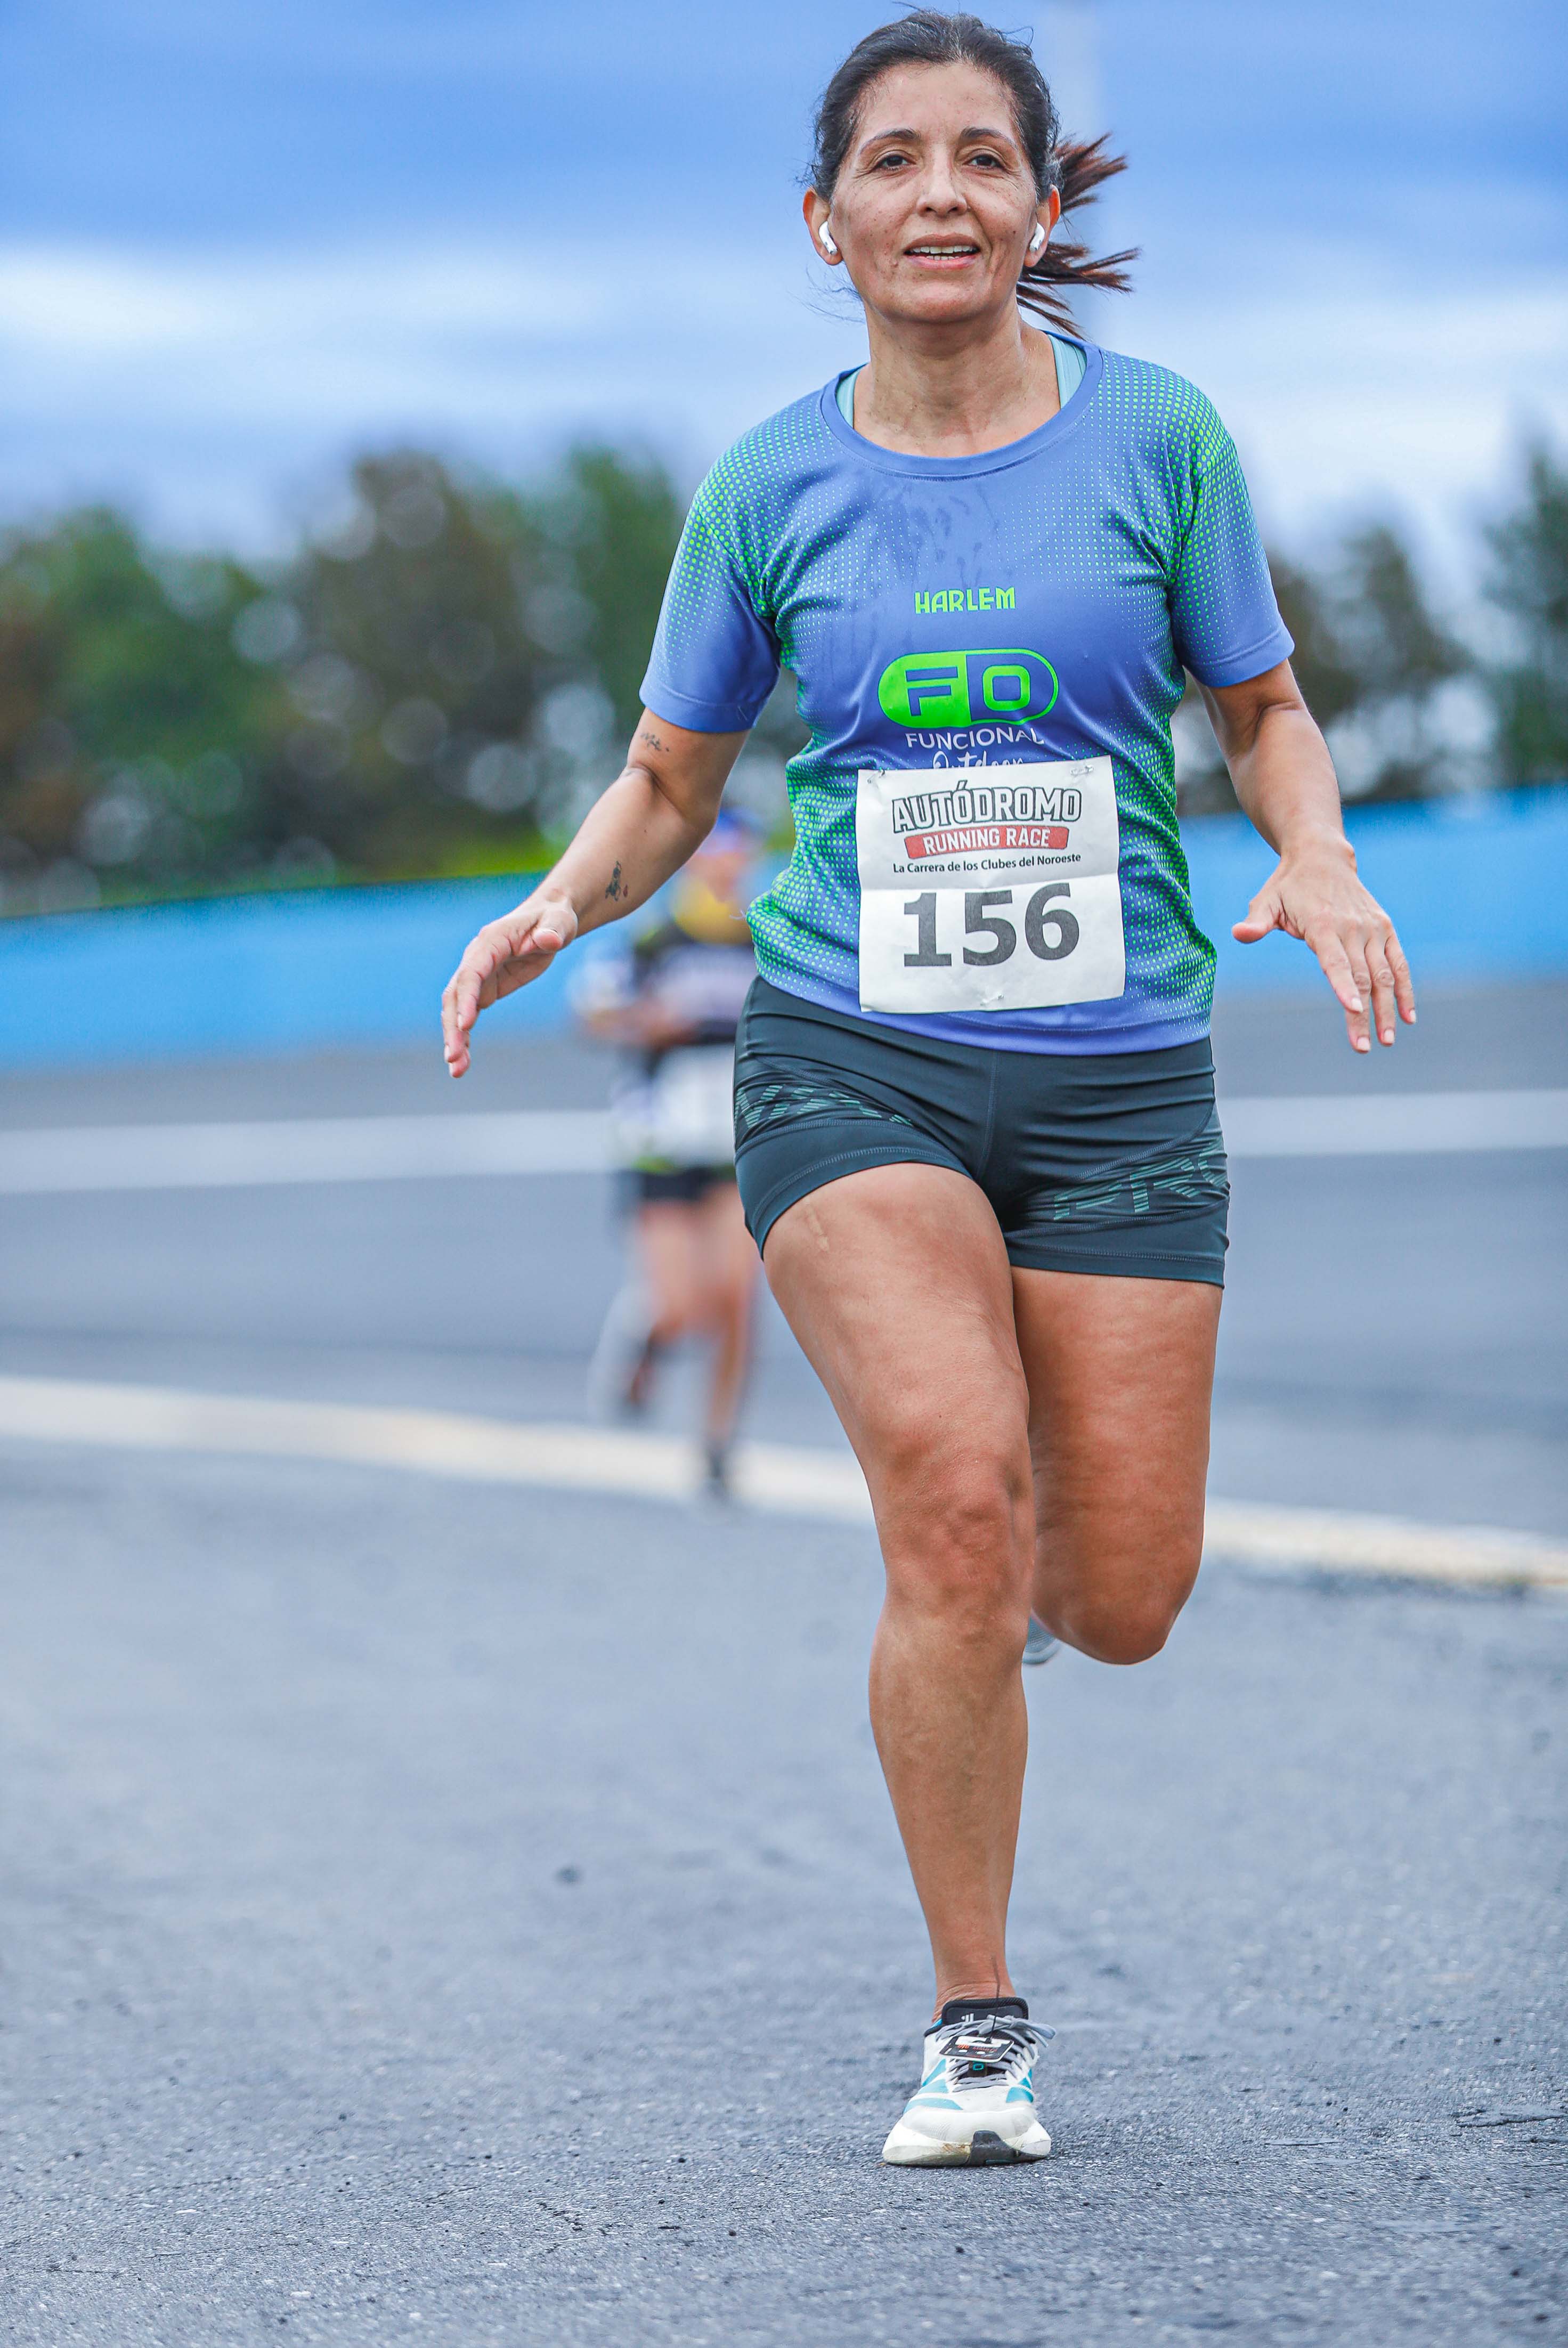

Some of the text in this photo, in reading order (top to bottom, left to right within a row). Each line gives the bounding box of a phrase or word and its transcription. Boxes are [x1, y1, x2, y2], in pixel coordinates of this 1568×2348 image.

[914, 587, 1015, 614] HARLEM
[905, 727, 1044, 750] FUNCIONAL
[891, 779, 1082, 833] AUTÓDROMO
[923, 826, 1051, 855] RUNNING RACE
[893, 852, 1081, 873] La Carrera de los Clubes del Noroeste
[904, 882, 1080, 967] 156
